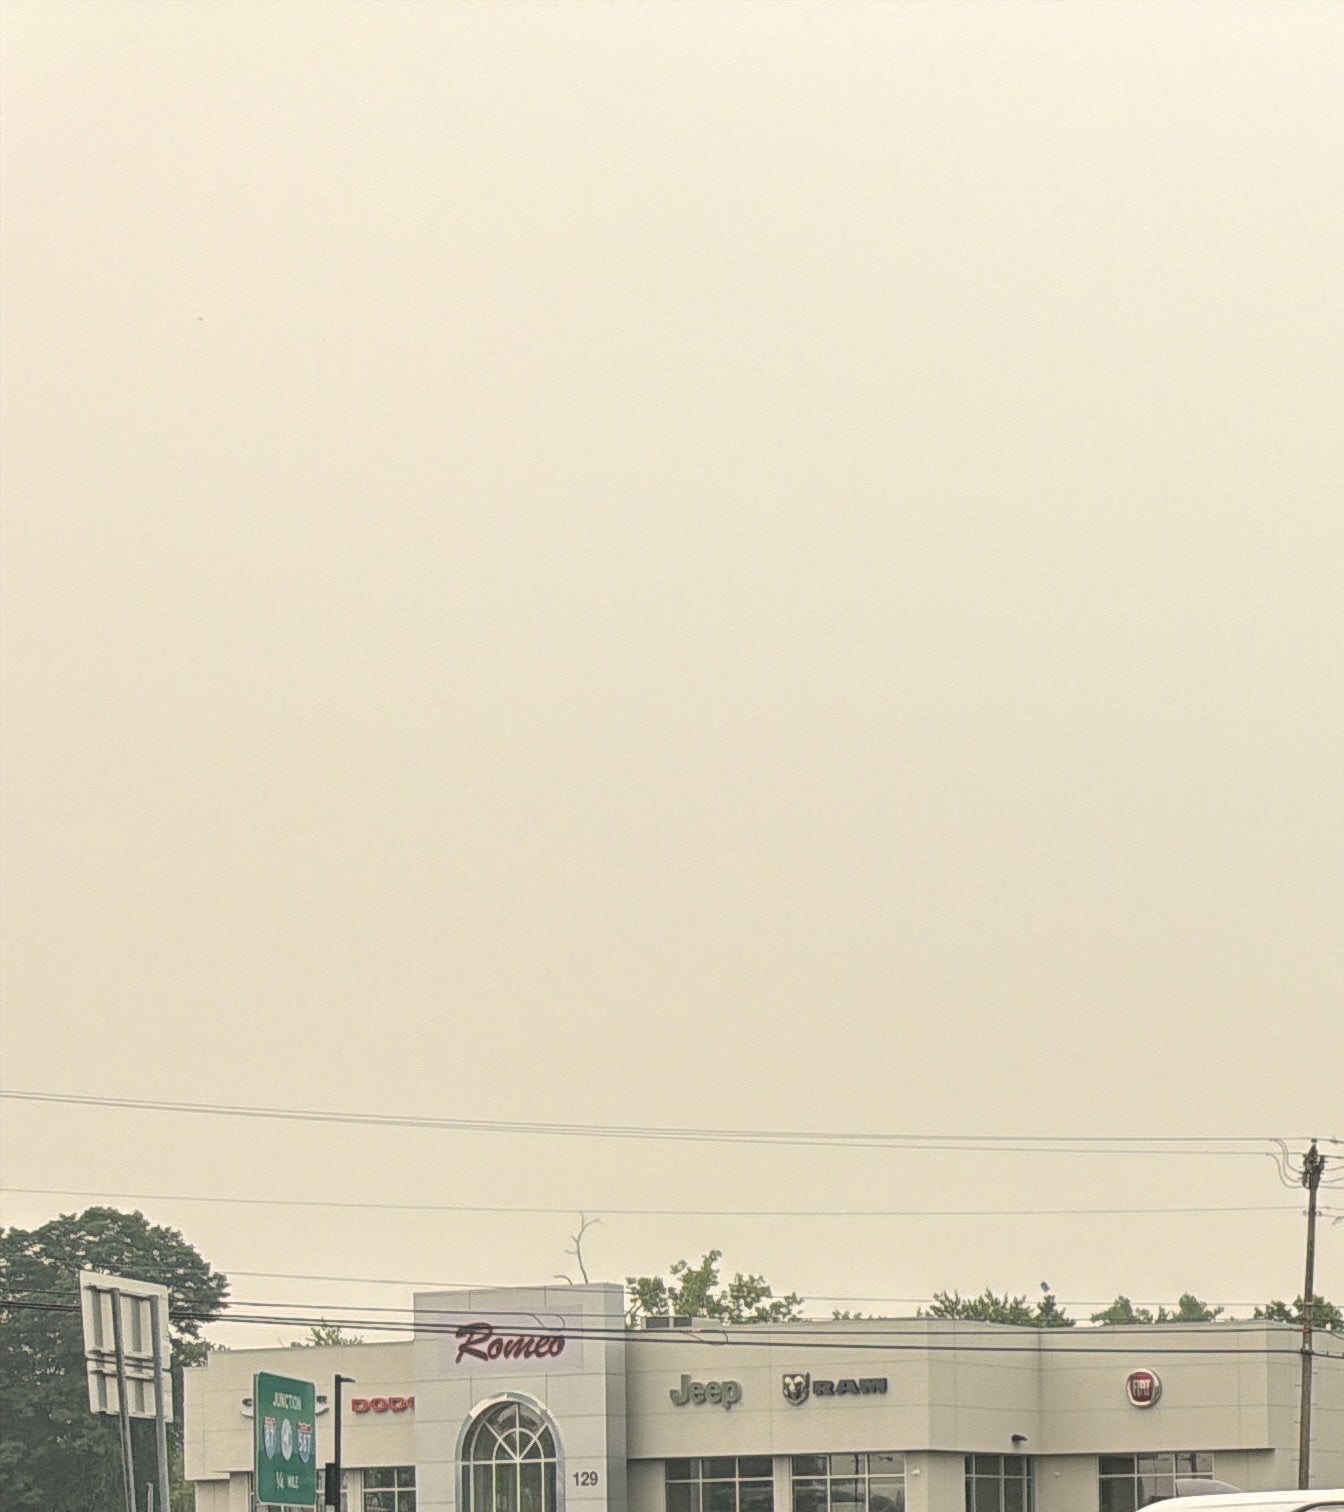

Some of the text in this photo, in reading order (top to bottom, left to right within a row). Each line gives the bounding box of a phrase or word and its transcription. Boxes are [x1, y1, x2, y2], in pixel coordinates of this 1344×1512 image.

[455, 1323, 565, 1364] Romeo
[669, 1374, 743, 1410] Jeep
[813, 1378, 888, 1396] RAM
[1132, 1379, 1151, 1397] FIAT
[273, 1391, 302, 1412] JUNCTION
[573, 1471, 599, 1487] 129
